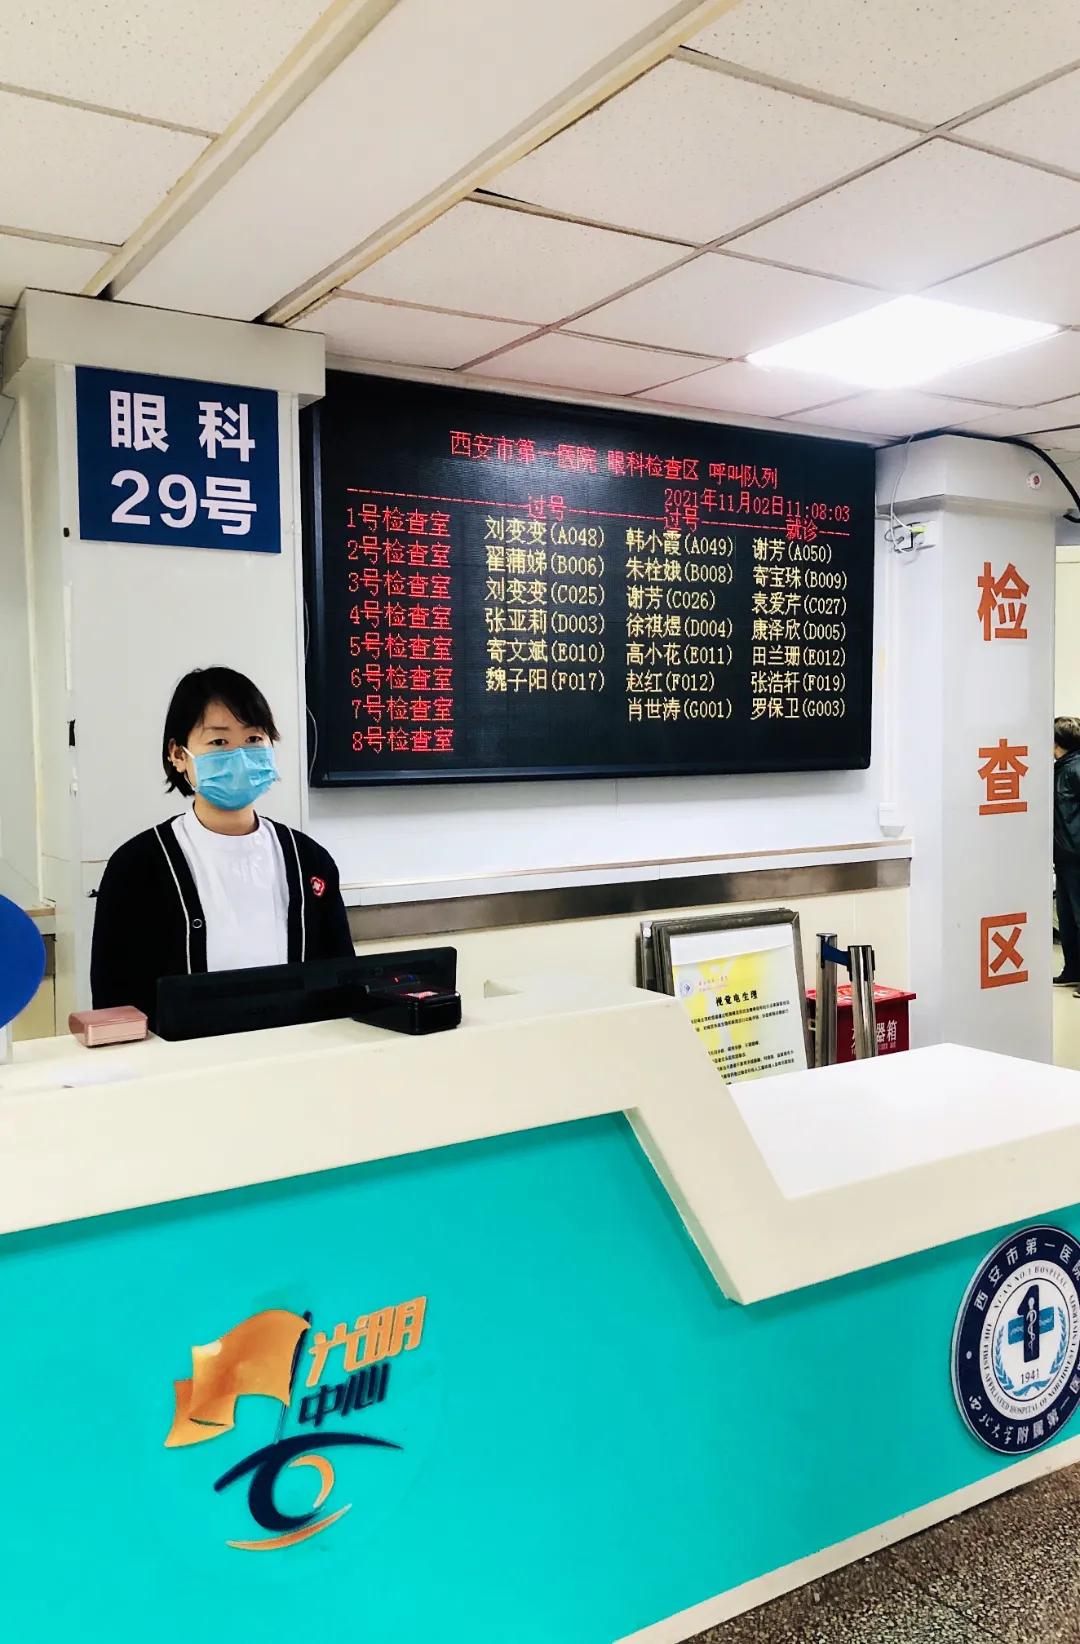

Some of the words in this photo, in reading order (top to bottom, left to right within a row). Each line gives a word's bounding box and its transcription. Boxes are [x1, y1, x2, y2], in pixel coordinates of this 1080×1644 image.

[110, 390, 256, 463] 眼科
[449, 430, 597, 474] 西安市第一医院
[606, 449, 699, 481] 眼科检查区
[708, 463, 778, 490] 呼叫队列
[110, 469, 257, 536] 29号
[527, 493, 566, 522] 过号
[663, 505, 700, 532] 过号
[785, 517, 819, 542] 就诊
[664, 488, 850, 522] 2021年11月02日11:08:03
[346, 503, 451, 537] 1号检查室
[484, 515, 605, 548] 刘变变(A048)
[625, 527, 734, 557] 韩小霞(A049)
[751, 536, 833, 563] 谢芳(A050)
[347, 535, 451, 568] 2号检查室
[752, 564, 848, 591] 寄宝珠(B009)
[348, 568, 451, 600] 3号检查室
[484, 576, 605, 606] 刘变变(C025)
[626, 584, 716, 611] 谢芳(C026)
[751, 591, 847, 616] 袁爱芹(C027)
[350, 600, 452, 630] 4号检查室
[484, 607, 605, 634] 张亚莉(D003)
[751, 617, 847, 642] 康泽欣(D005)
[350, 632, 453, 661] 5号检查室
[486, 638, 605, 663] 寄文斌(E010)
[626, 641, 733, 667] 高小花(E011)
[752, 644, 846, 667] 田兰珊(E012)
[350, 663, 454, 692] 6号检查室
[485, 666, 605, 693] 魏子阳(F017)
[626, 671, 715, 693] 赵红(F012)
[751, 671, 846, 694] 张浩轩(F019)
[351, 694, 454, 723] 7号检查室
[627, 696, 733, 722] 肖世涛(G001)
[751, 697, 846, 721] 罗保卫(G003)
[352, 726, 454, 754] 8号检查室
[977, 561, 1030, 990] 检查区
[307, 1296, 426, 1387] 光明
[299, 1362, 391, 1427] 中心
[968, 1357, 1080, 1445] 西北大学附属第一医
[1021, 1368, 1040, 1384] 1941
